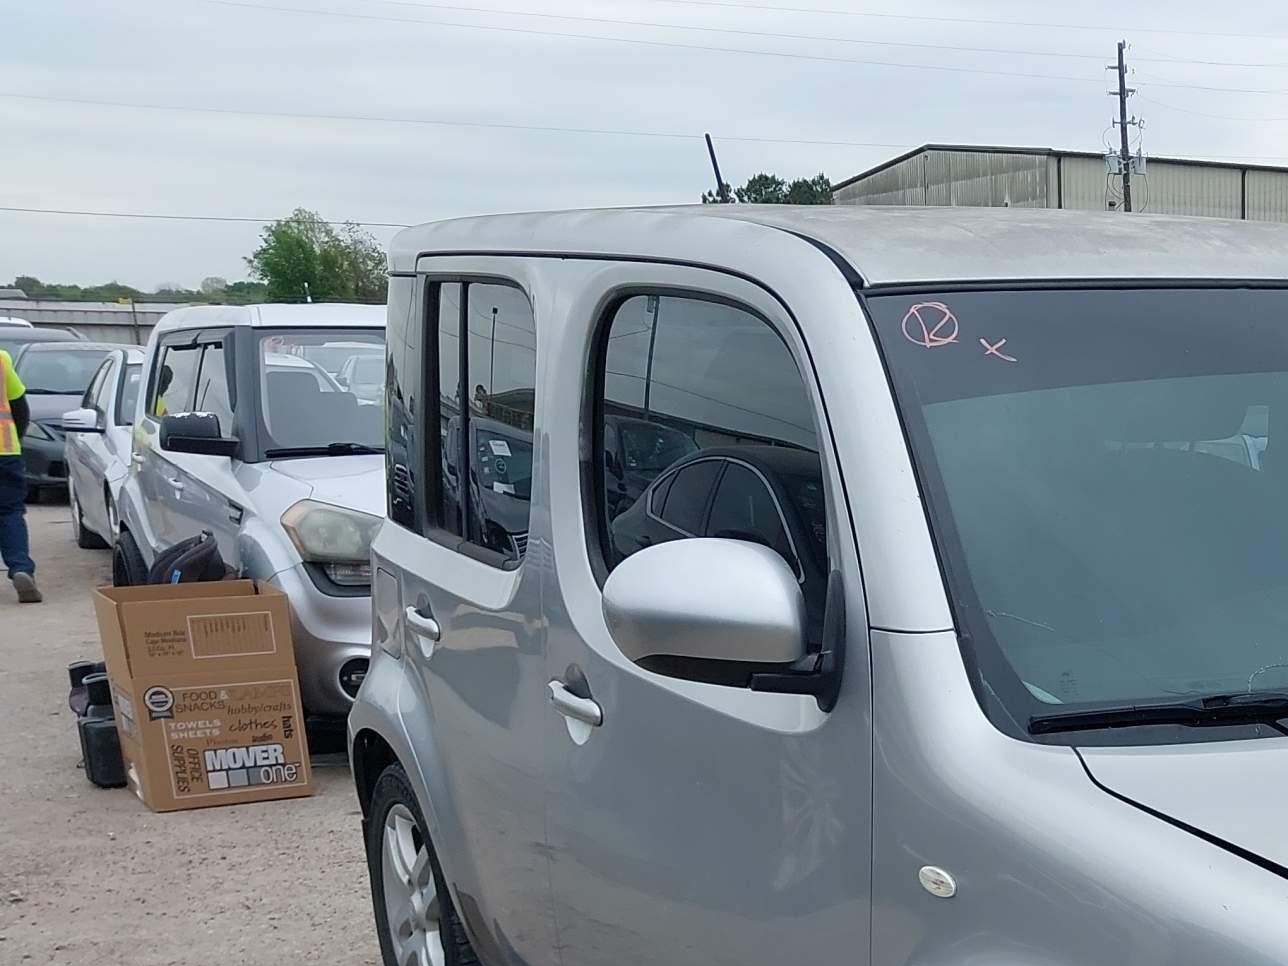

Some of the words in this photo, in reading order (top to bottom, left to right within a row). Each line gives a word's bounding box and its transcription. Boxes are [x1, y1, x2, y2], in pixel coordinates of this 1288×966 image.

[182, 690, 217, 701] FOOD
[174, 701, 225, 714] SNACKS
[168, 719, 222, 730] TOWELS
[228, 719, 278, 732] clothes
[170, 728, 221, 739] SHEETS
[204, 743, 285, 771] MOVER
[170, 744, 192, 792] SUPPLIES
